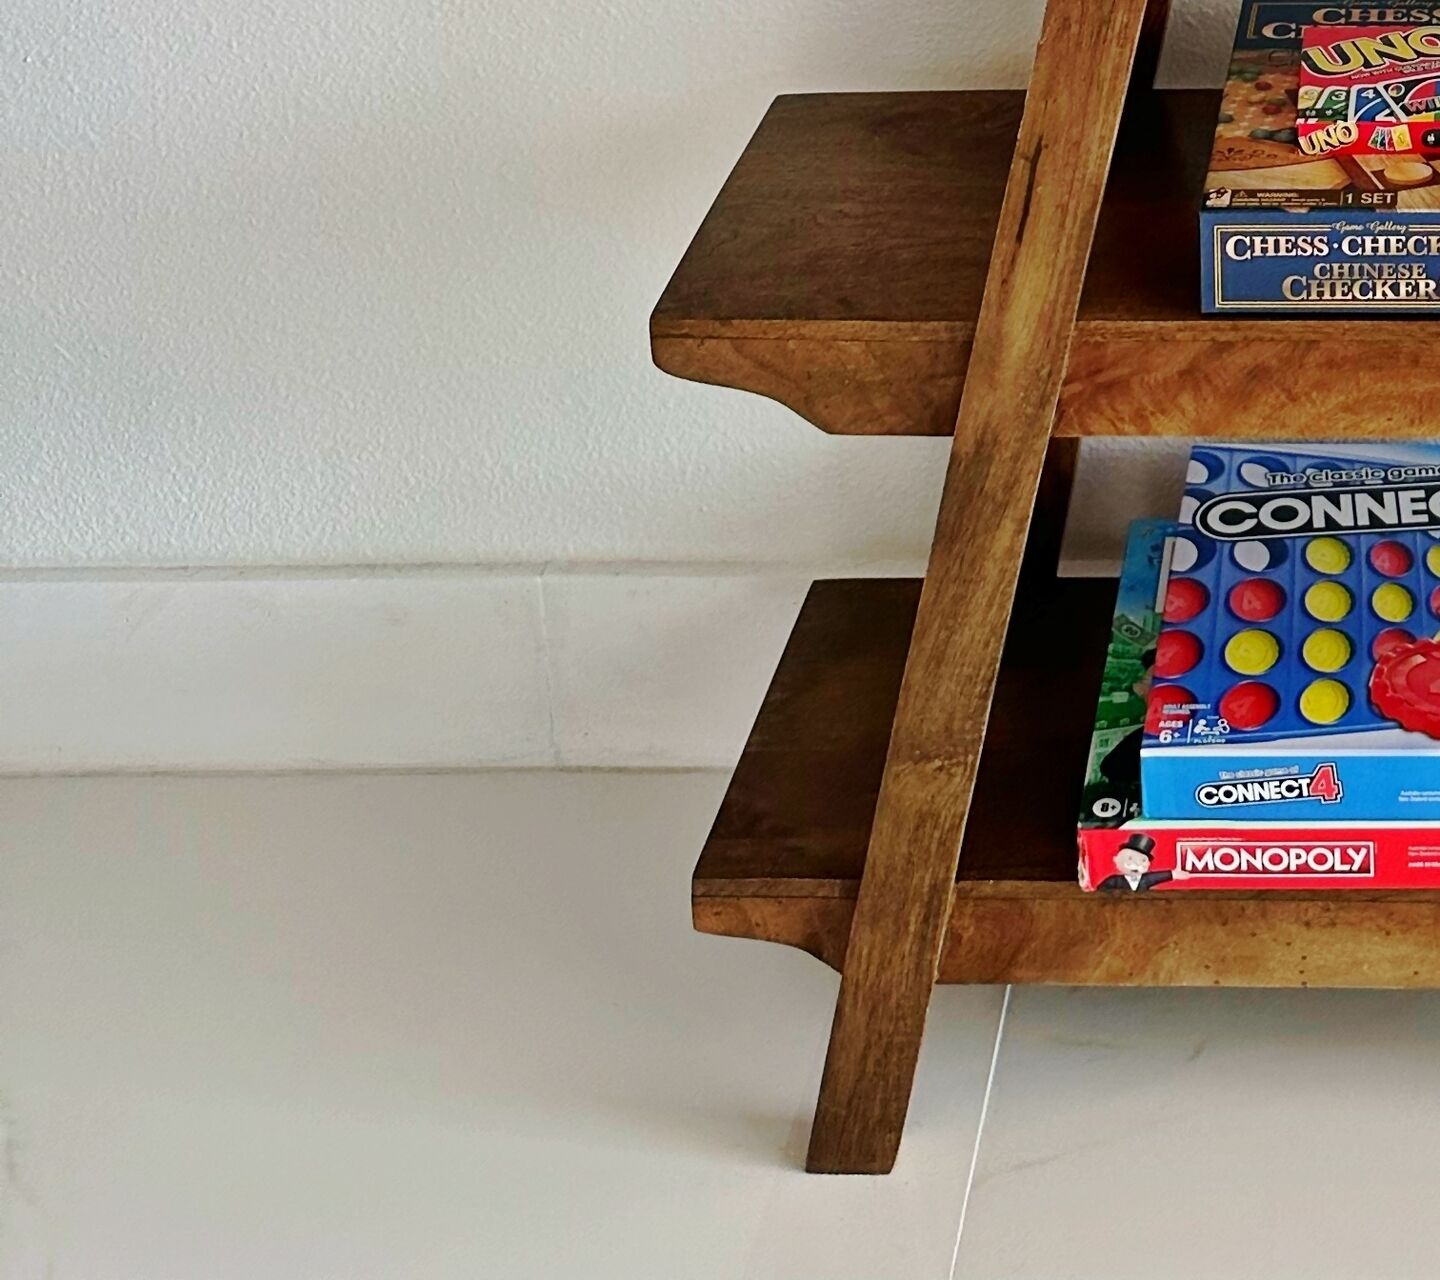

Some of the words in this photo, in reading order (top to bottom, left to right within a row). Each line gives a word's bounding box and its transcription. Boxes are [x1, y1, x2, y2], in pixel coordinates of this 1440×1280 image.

[1360, 89, 1376, 99] 4
[1298, 121, 1358, 155] UNO
[1346, 193, 1353, 204] 1
[1360, 192, 1395, 205] SET
[1225, 235, 1329, 260] CHESS
[1313, 263, 1427, 280] CHINESE
[1266, 471, 1305, 486] The
[1307, 467, 1382, 484] classic
[1158, 720, 1184, 728] AGES
[1159, 730, 1181, 744] 6+
[1198, 778, 1311, 806] CONNECT
[1185, 847, 1368, 873] MONOPOLY
